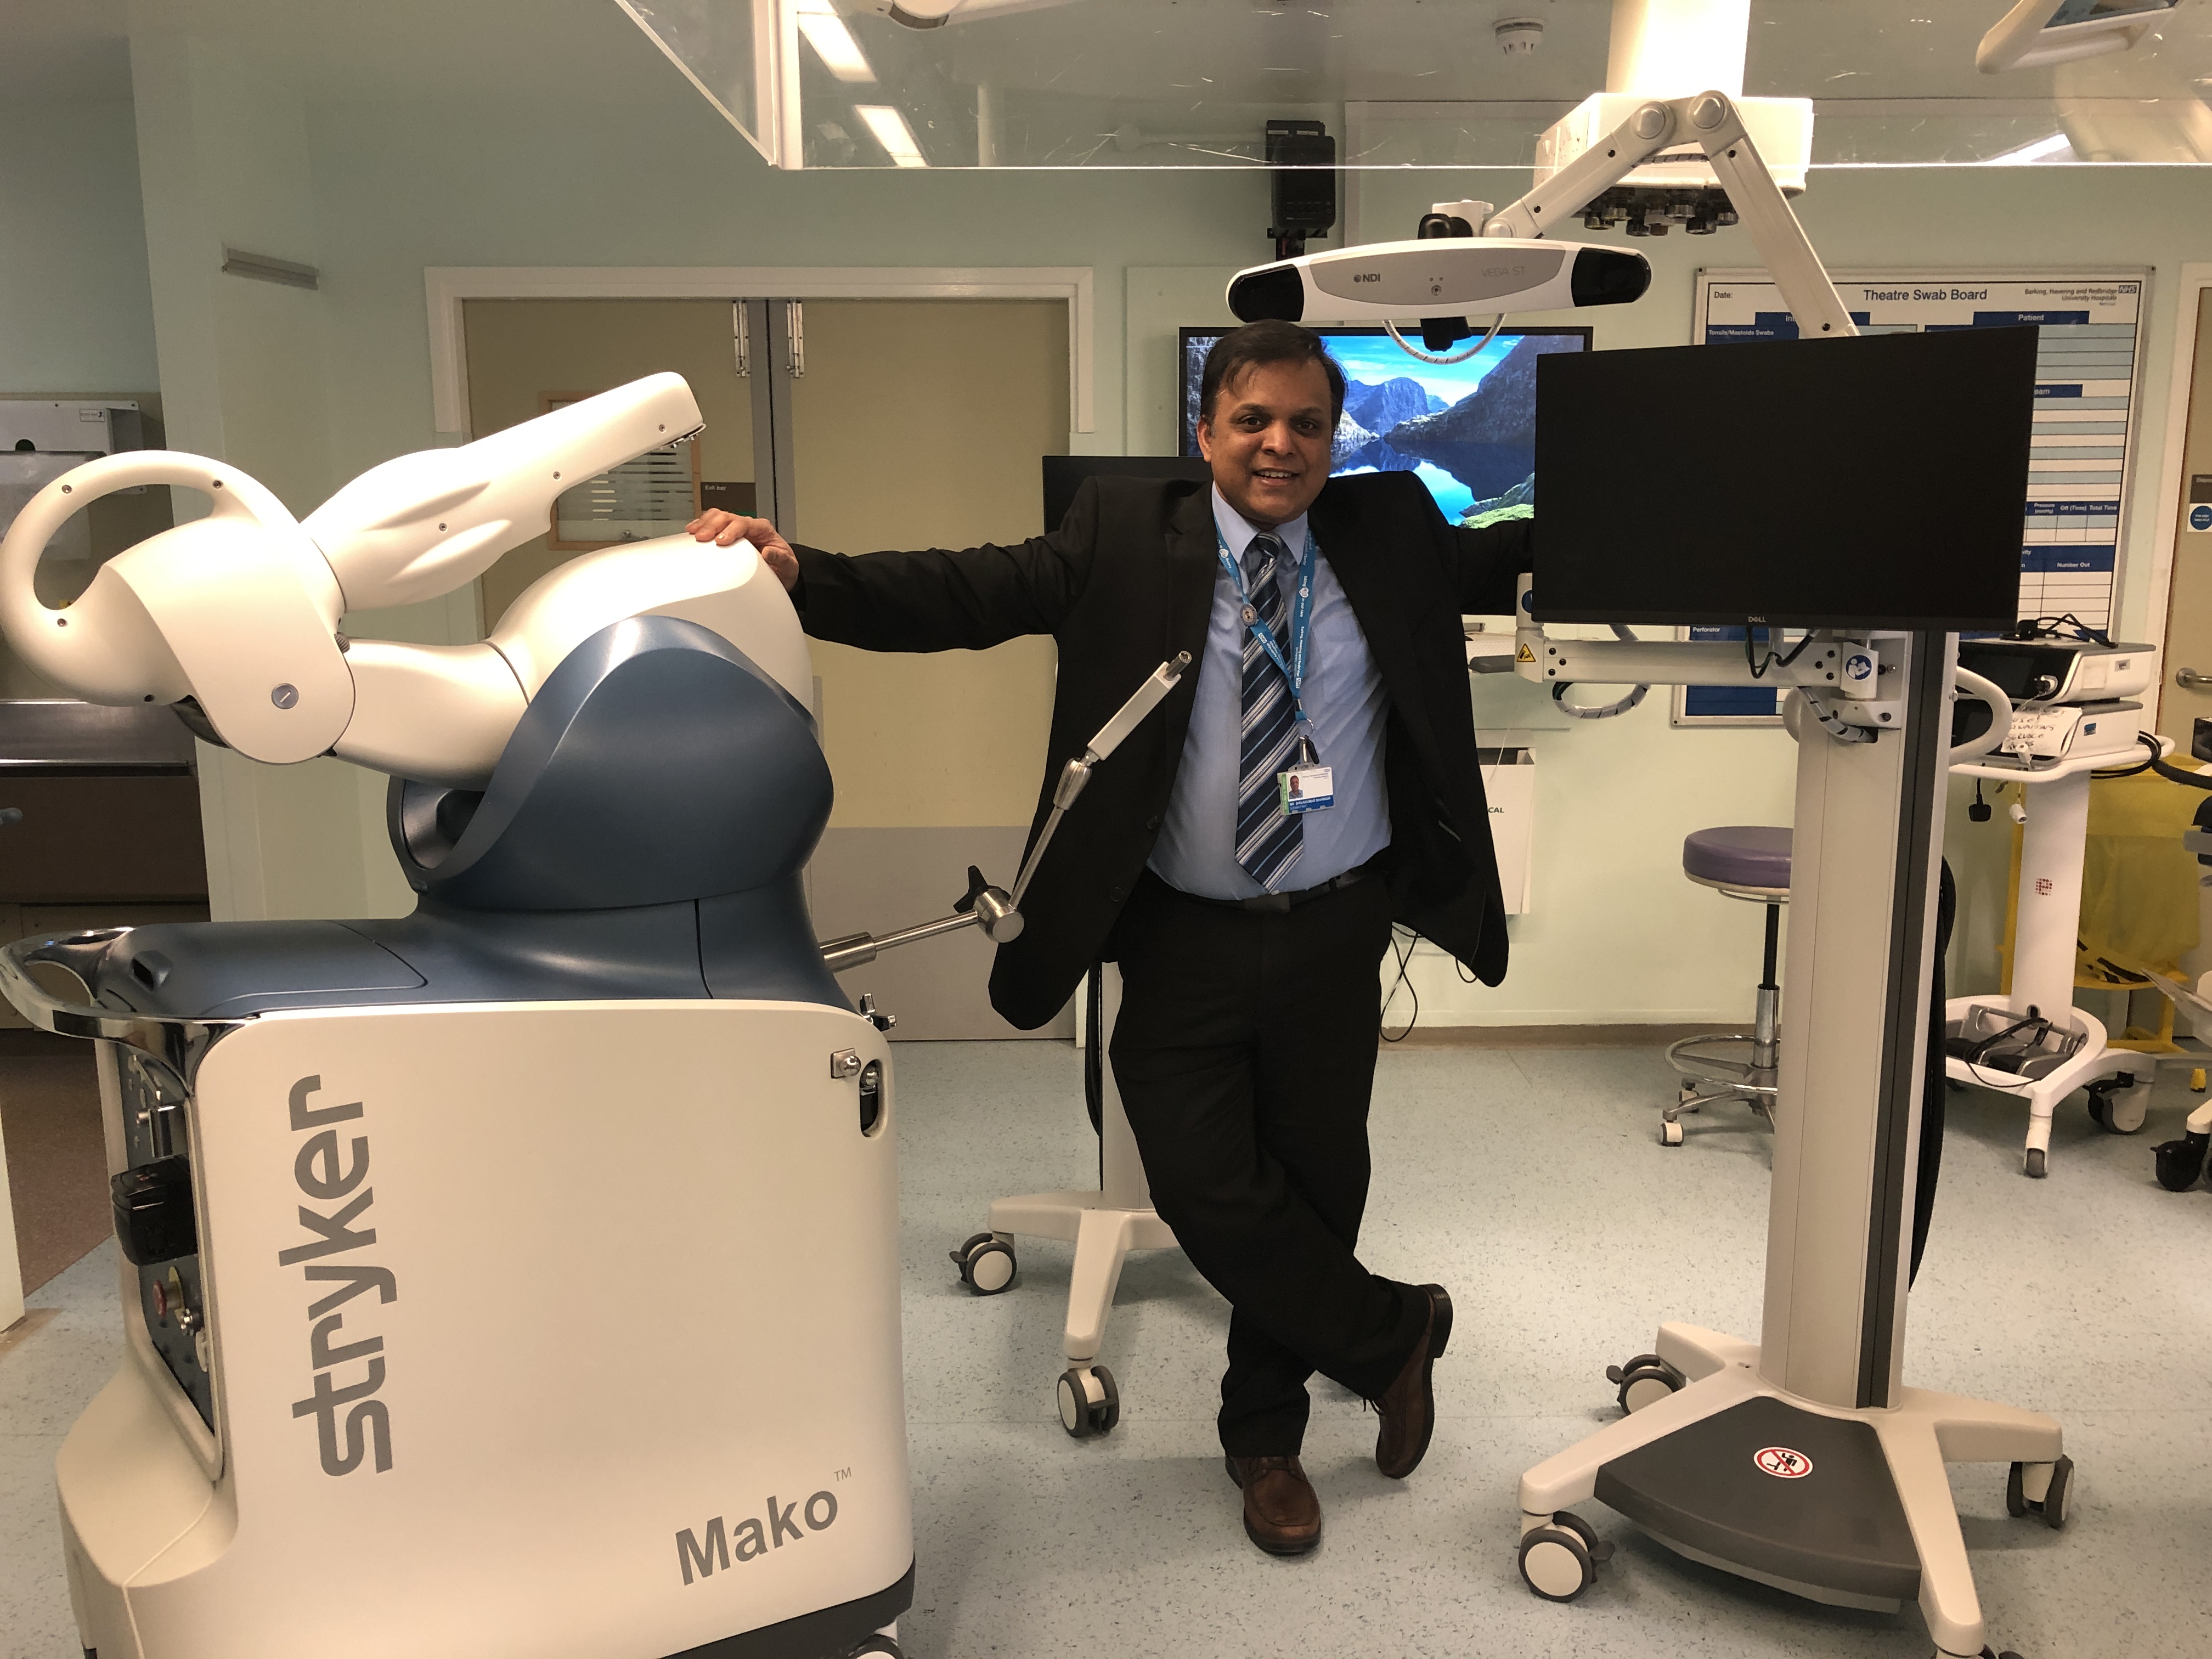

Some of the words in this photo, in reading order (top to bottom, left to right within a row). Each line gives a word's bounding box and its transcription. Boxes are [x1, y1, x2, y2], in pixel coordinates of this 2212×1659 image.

[1482, 267, 1509, 277] VEGA
[1512, 266, 1526, 275] ST
[1362, 273, 1381, 283] NDI
[1714, 291, 1733, 299] Date:
[1864, 290, 1909, 301] Theatre
[1913, 289, 1947, 301] Swab
[1951, 289, 1988, 300] Board
[278, 1074, 398, 1478] stryker
[675, 1490, 838, 1587] Mako
